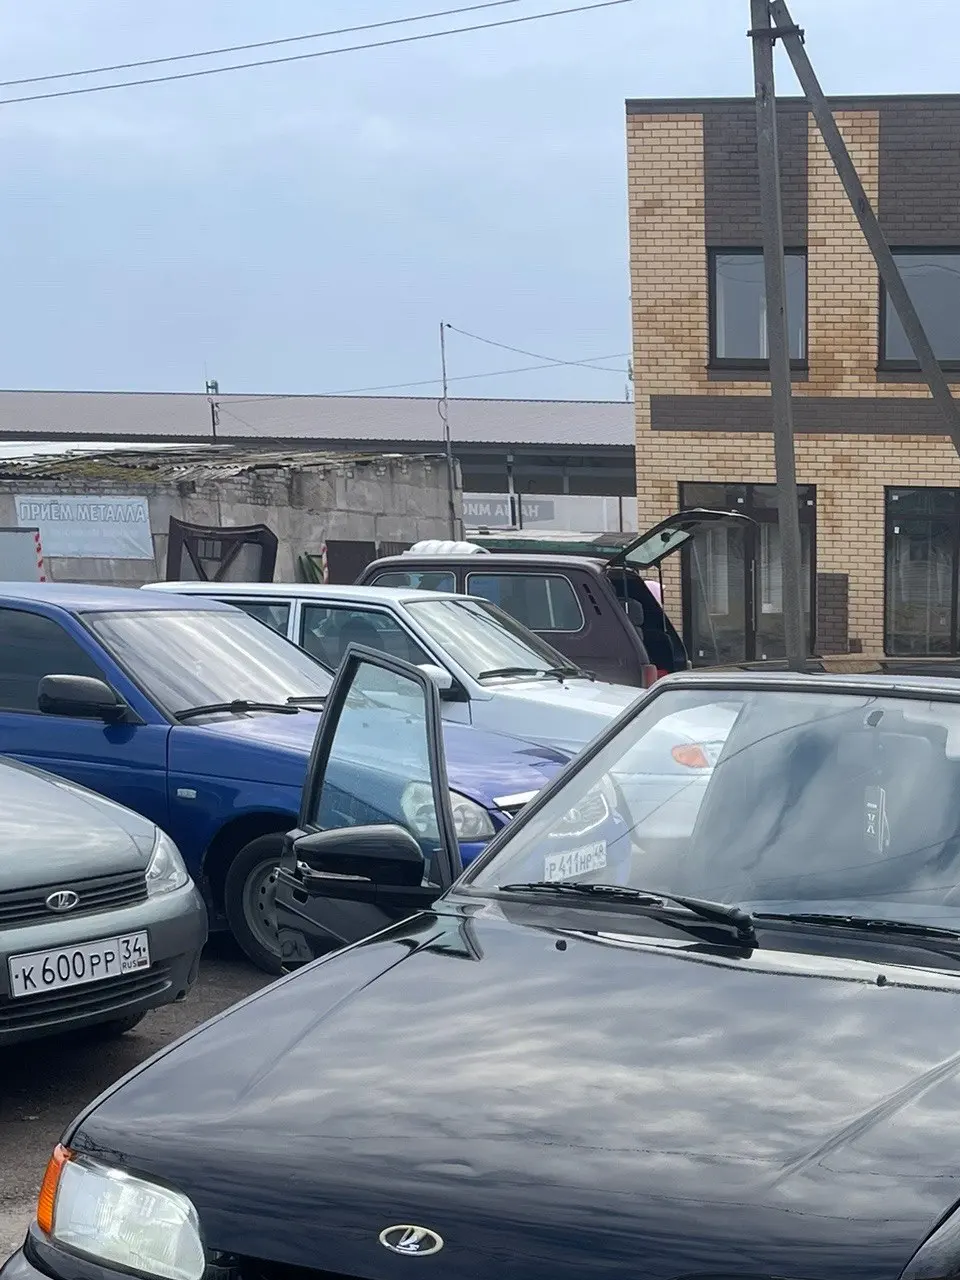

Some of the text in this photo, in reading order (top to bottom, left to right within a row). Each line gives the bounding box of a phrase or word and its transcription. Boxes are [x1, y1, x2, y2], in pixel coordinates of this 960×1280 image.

[20, 500, 148, 522] ПРИЁМ МЕТАЛЛА
[22, 937, 141, 990] К600РР 34
[122, 961, 137, 970] RUS
